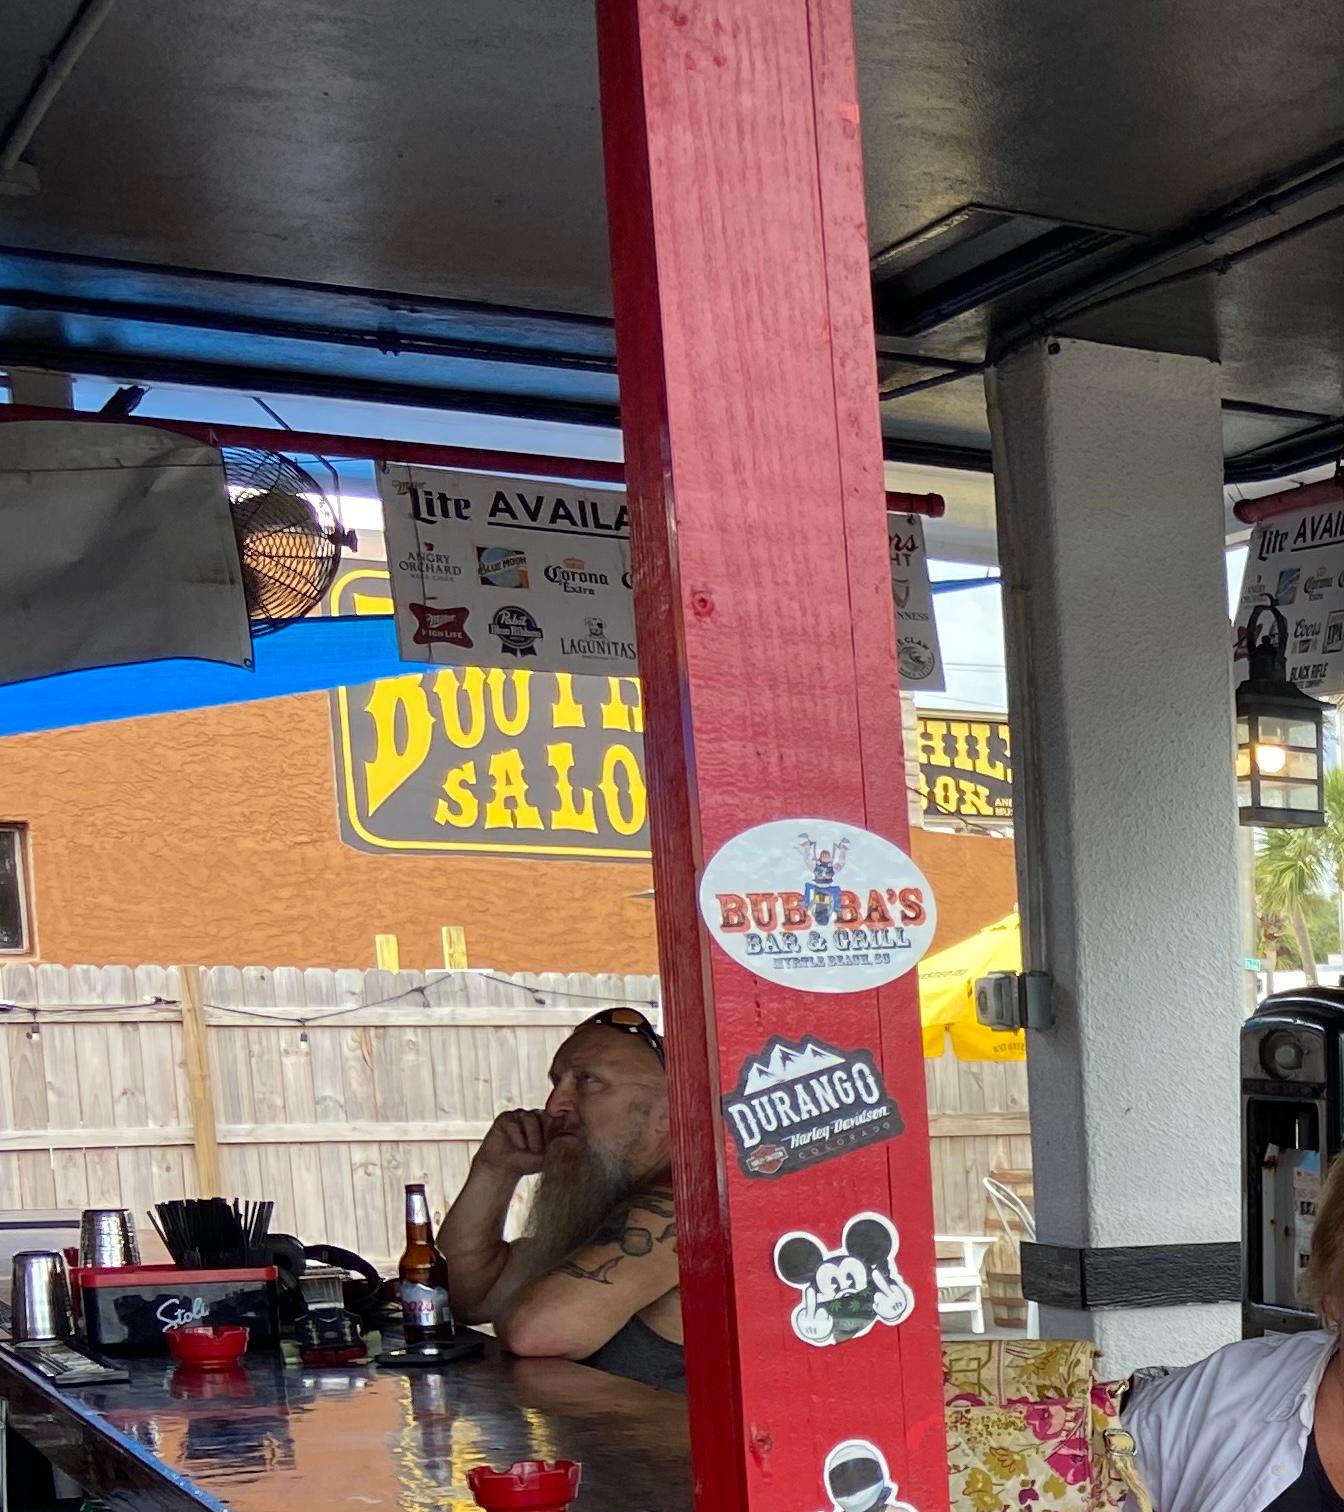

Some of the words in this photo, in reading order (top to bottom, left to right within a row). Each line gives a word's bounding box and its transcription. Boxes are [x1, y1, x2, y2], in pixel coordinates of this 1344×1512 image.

[410, 487, 472, 525] Lite
[399, 560, 462, 576] ORCHARD
[544, 565, 608, 586] Corona
[563, 582, 595, 596] Extra
[561, 637, 637, 660] LAGUNITAS
[745, 931, 802, 955] BAR
[806, 931, 828, 952] &
[832, 926, 912, 951] GRILL
[728, 1062, 880, 1148] DURANGO
[798, 1121, 891, 1160] COLORADO
